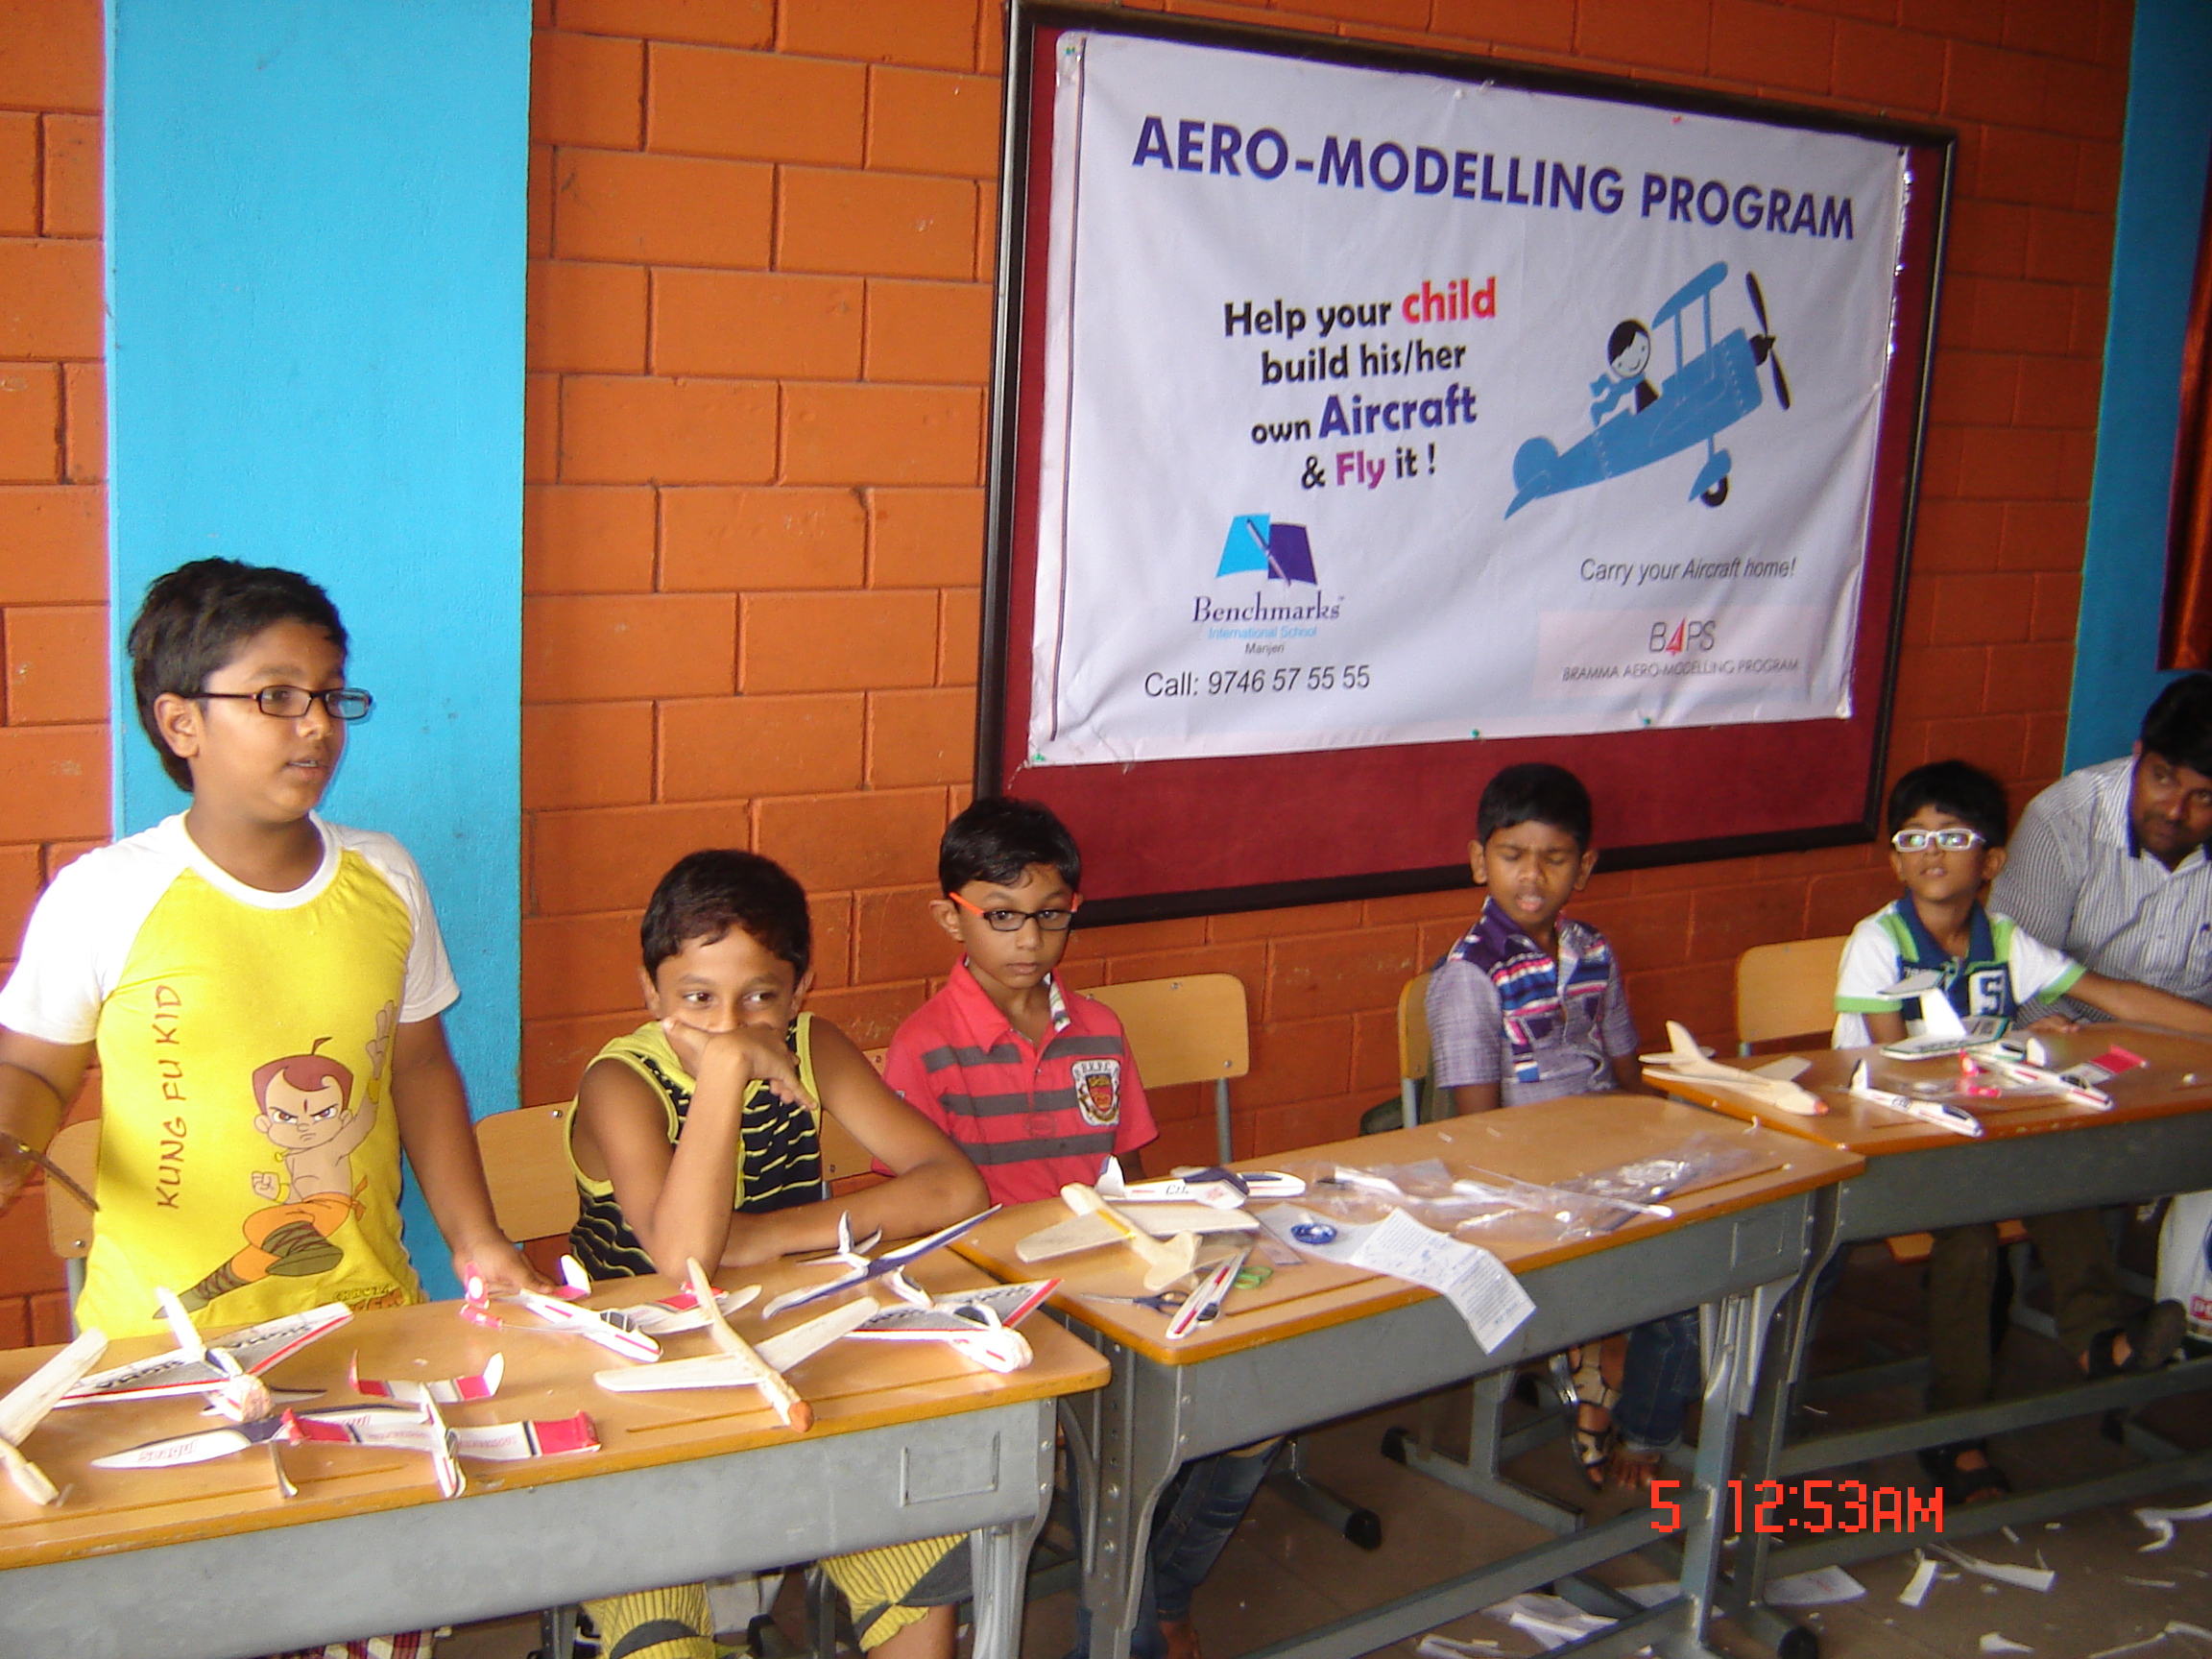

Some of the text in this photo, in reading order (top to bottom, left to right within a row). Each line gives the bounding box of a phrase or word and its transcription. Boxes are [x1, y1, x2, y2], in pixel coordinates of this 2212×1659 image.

[1132, 114, 1854, 240] AERO-MODELLING PROGRAM
[1224, 276, 1497, 339] Help your child
[1261, 338, 1466, 385] build his/her
[1251, 382, 1478, 445] own Aircraft
[1301, 454, 1326, 490] &
[1335, 449, 1385, 490] Fly
[1580, 557, 1797, 587] Carry your Aircraft home!
[1192, 590, 1340, 623] Benchmarks
[1208, 625, 1317, 639] International School
[1244, 642, 1286, 657] Manjeri
[1144, 664, 1371, 697] Call: 9746 57 55 55
[1561, 664, 1620, 683] BRAMMA
[1737, 658, 1799, 673] PROGRAM
[152, 984, 188, 1210] KUNG FU KID
